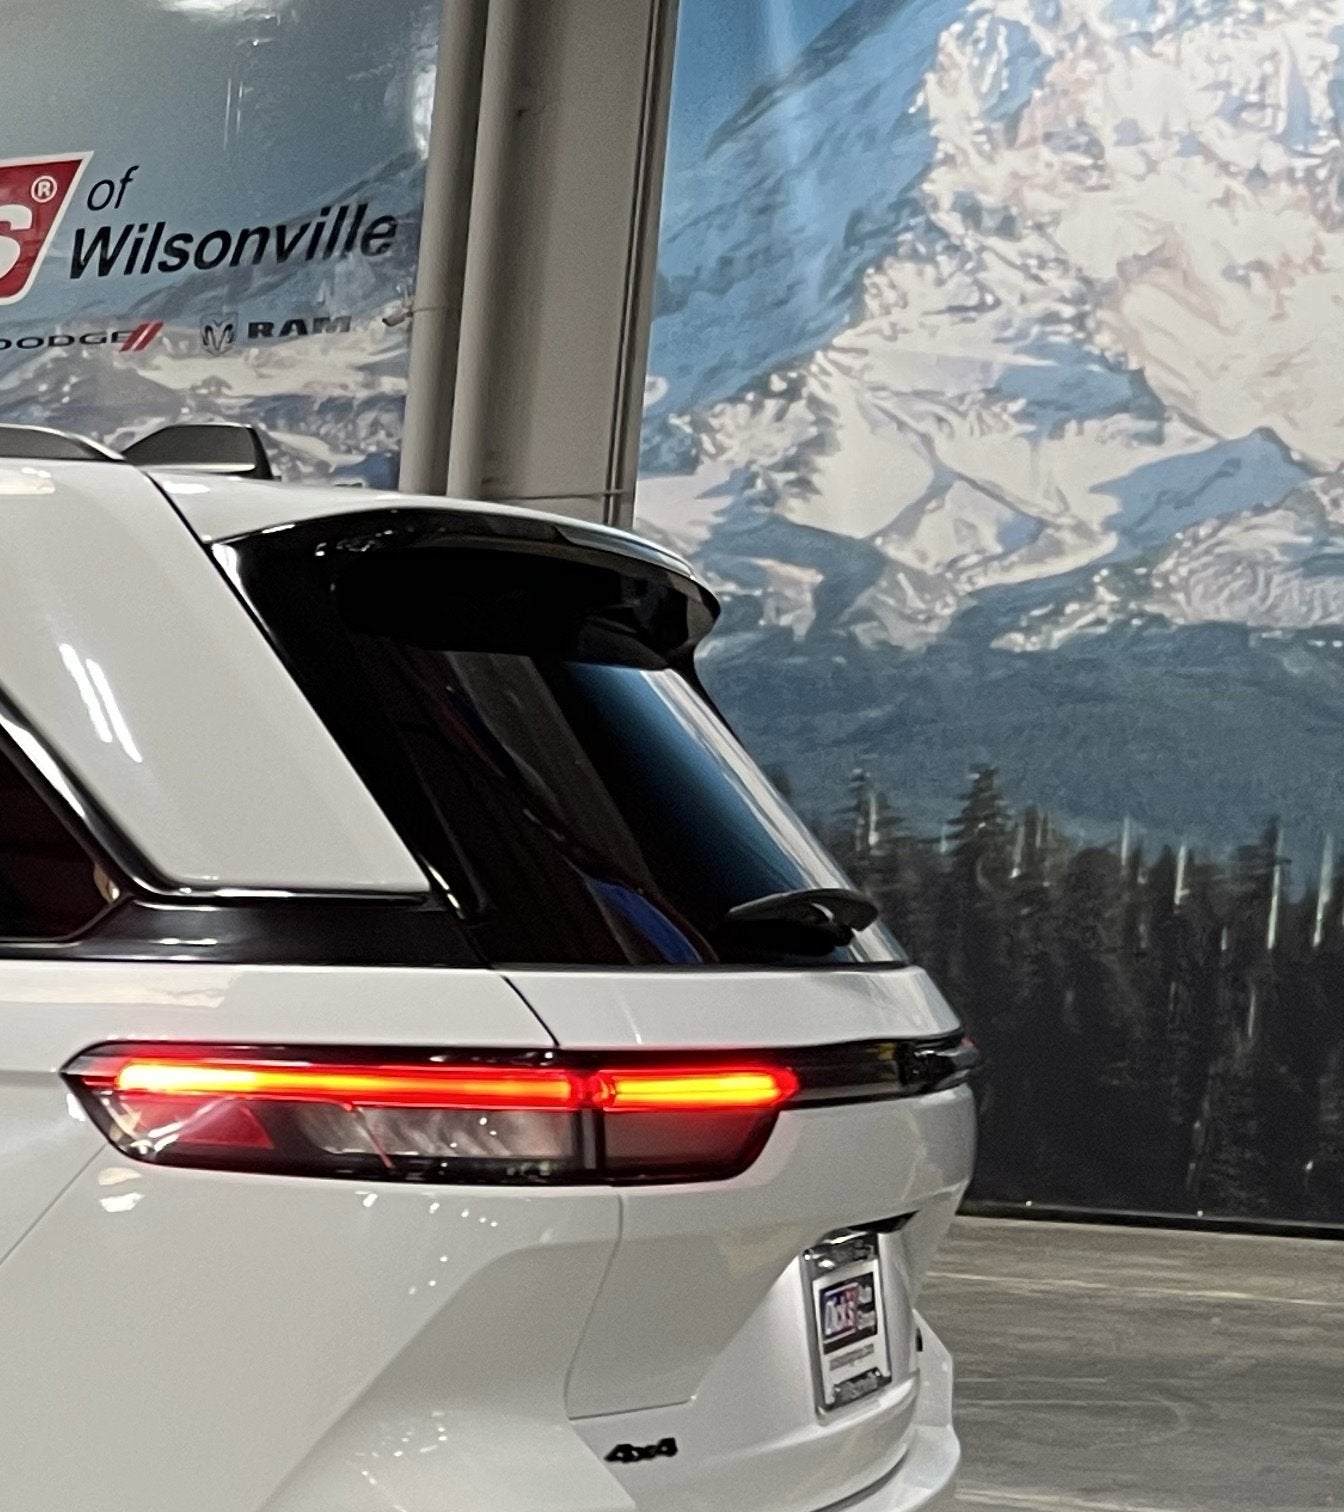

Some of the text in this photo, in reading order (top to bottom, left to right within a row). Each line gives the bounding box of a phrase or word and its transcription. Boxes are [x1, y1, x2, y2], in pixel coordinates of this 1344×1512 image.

[86, 165, 141, 212] of
[68, 202, 399, 280] Wilsonville
[247, 315, 353, 339] RAM
